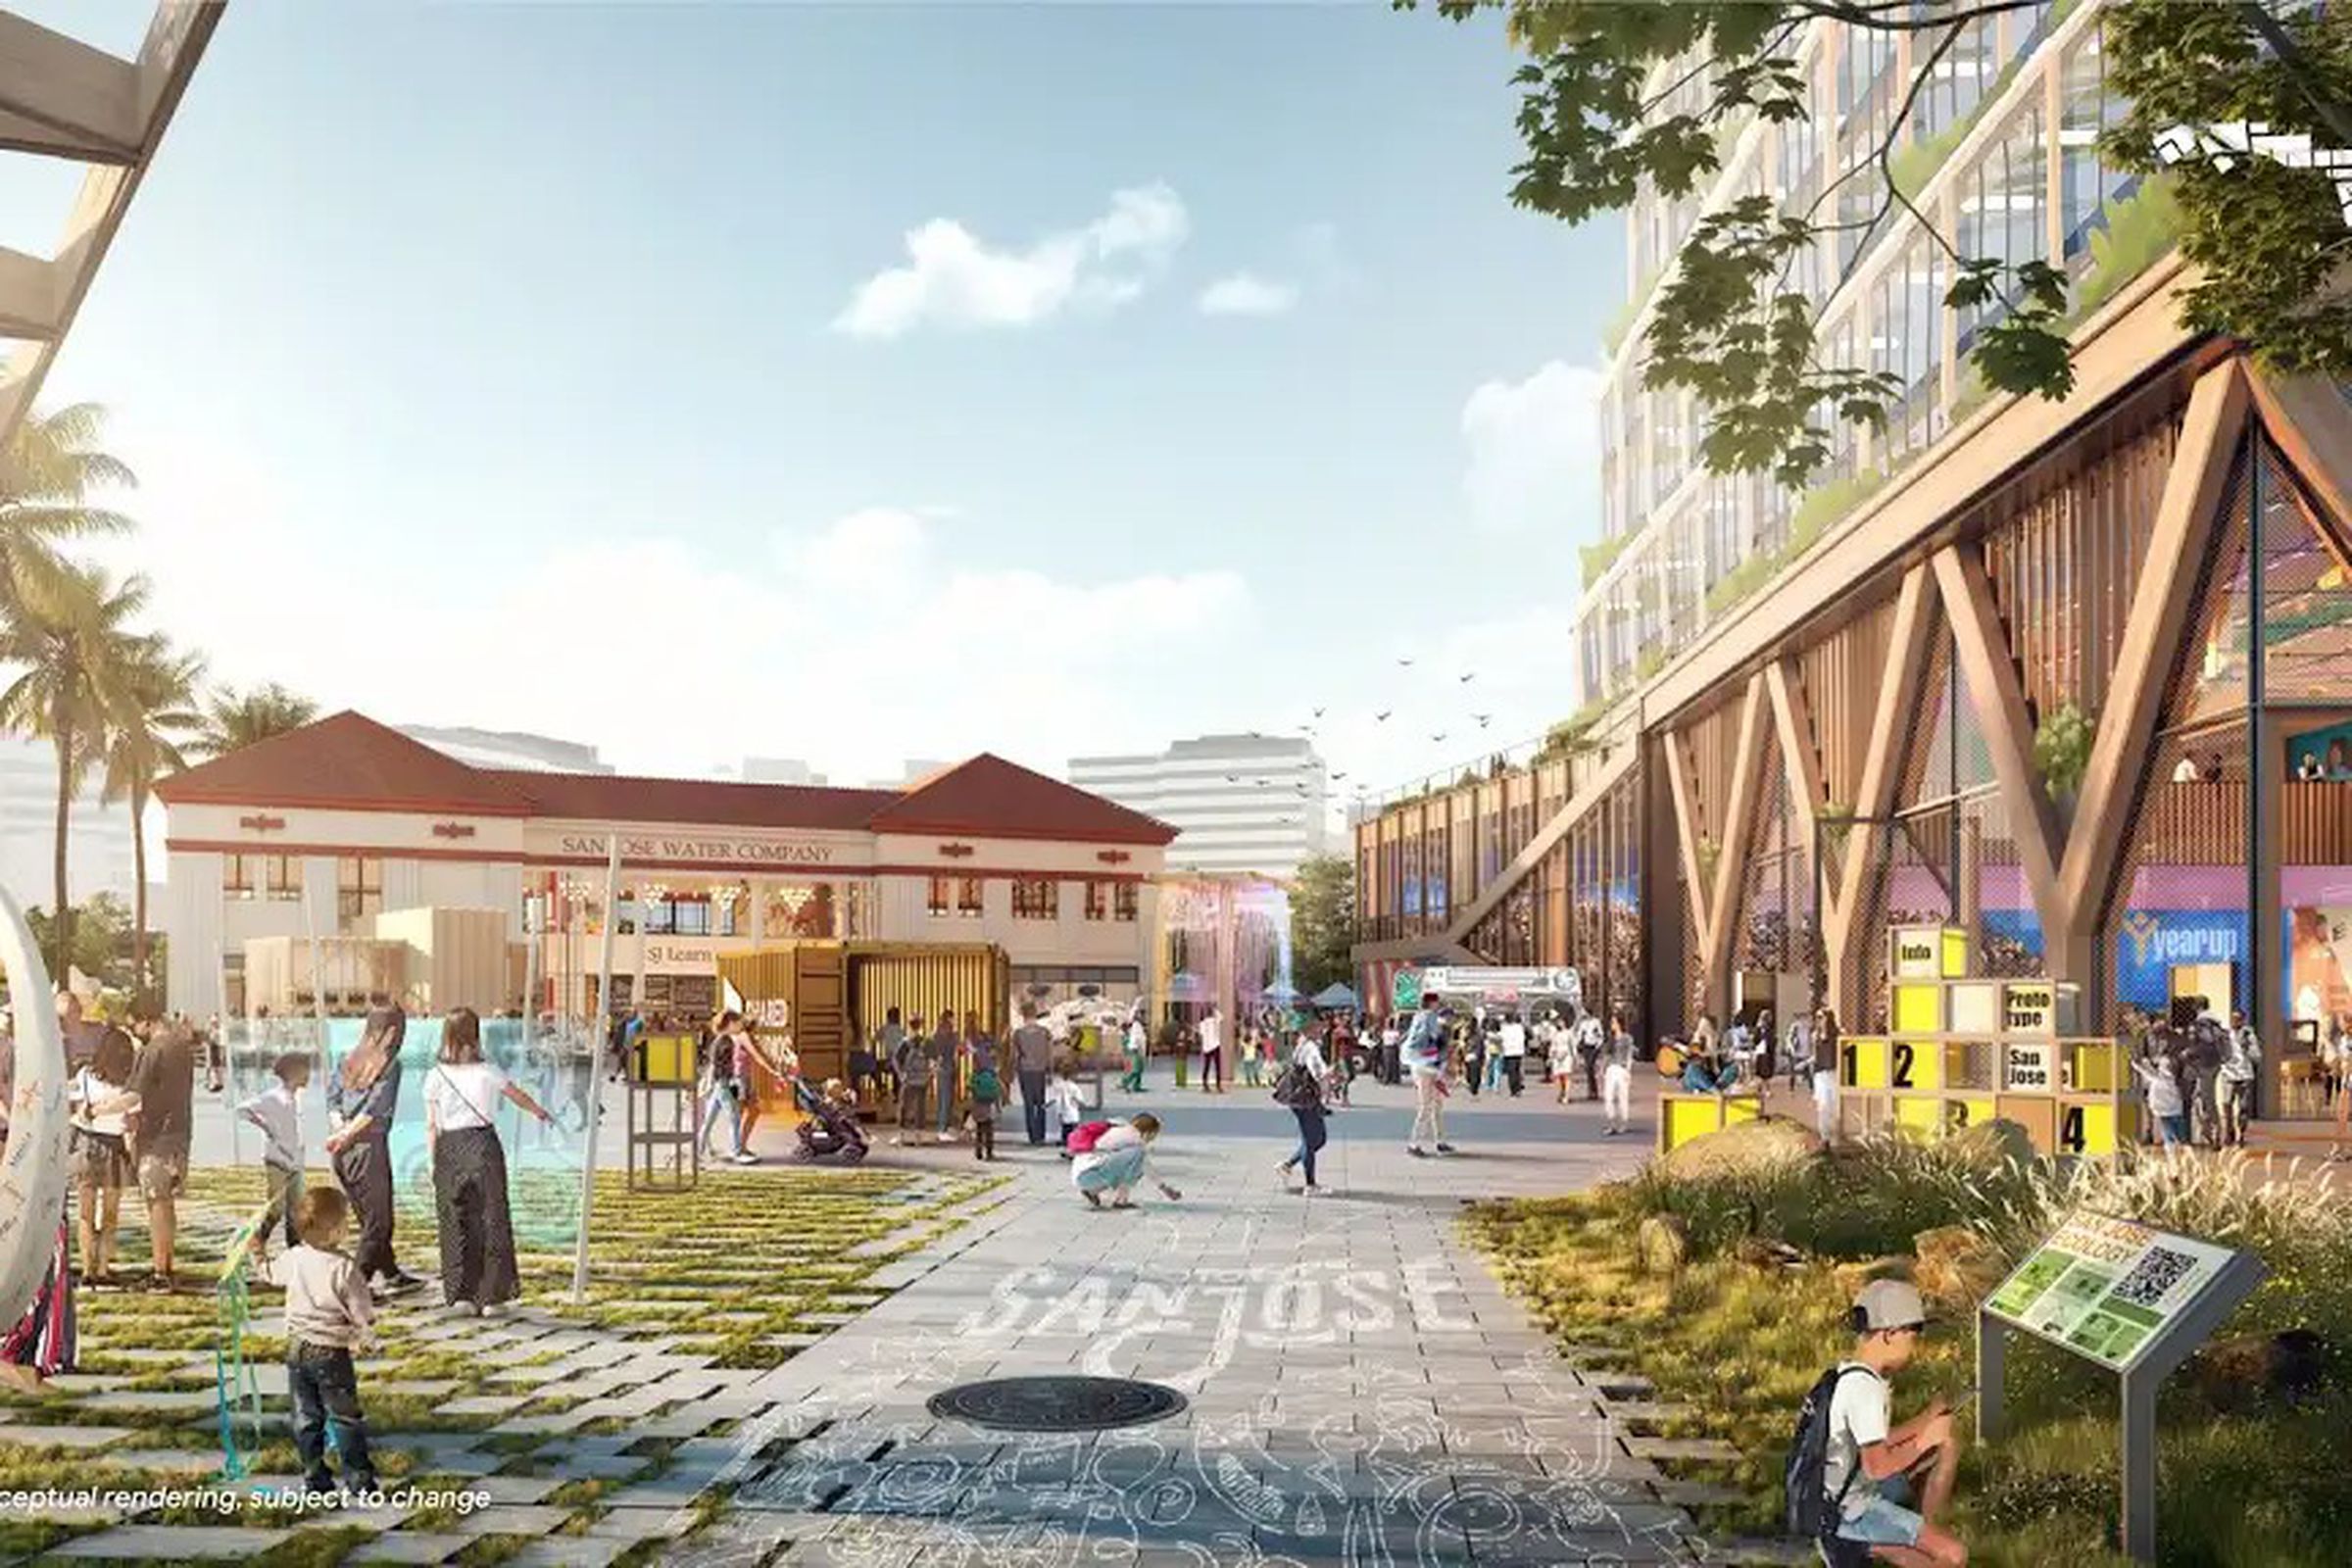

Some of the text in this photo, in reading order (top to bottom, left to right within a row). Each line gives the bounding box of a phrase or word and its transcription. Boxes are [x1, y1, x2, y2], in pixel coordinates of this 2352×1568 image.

[563, 837, 833, 862] SAN OSE WATER COMPANY
[648, 945, 713, 965] SJ Learn
[1902, 944, 1931, 961] Info
[2007, 991, 2050, 1008] Proto
[1842, 1045, 1857, 1087] 1
[1892, 1044, 1914, 1088] 2
[2010, 1049, 2040, 1065] San
[2009, 1067, 2046, 1085] Jose
[2062, 1106, 2085, 1152] 4
[955, 1261, 1193, 1335] SAN
